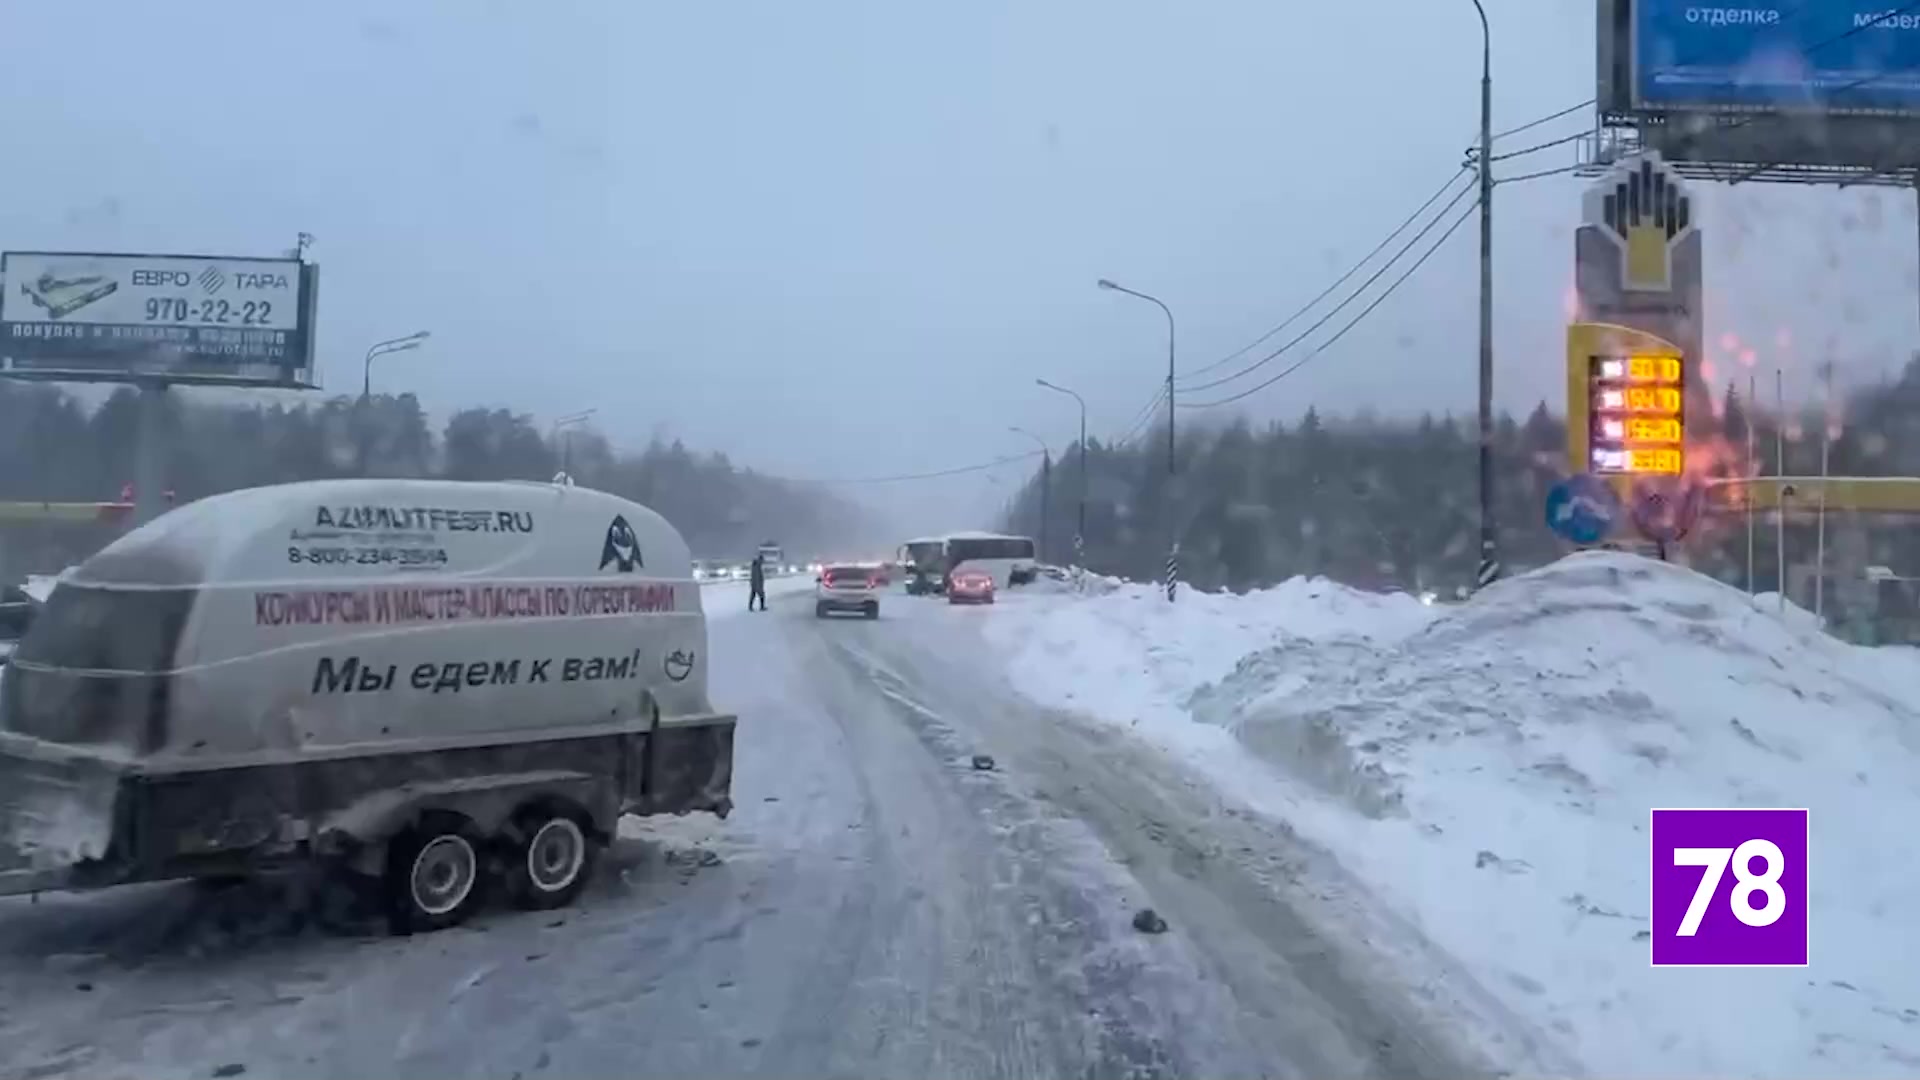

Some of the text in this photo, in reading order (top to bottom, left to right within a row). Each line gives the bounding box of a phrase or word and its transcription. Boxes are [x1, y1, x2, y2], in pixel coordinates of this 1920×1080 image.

[1685, 6, 1781, 25] отделка
[131, 269, 288, 291] ЕВРО ТАРА
[145, 297, 272, 325] 970-22-22
[315, 504, 533, 534] AZIMUTFEST.RU
[254, 591, 369, 625] КОНКУРСЫ
[373, 588, 391, 625] И
[396, 586, 540, 621] МАСТЕР-КЛАССЫ
[545, 586, 570, 616] ПО
[311, 647, 640, 694] Мы едем к вам!
